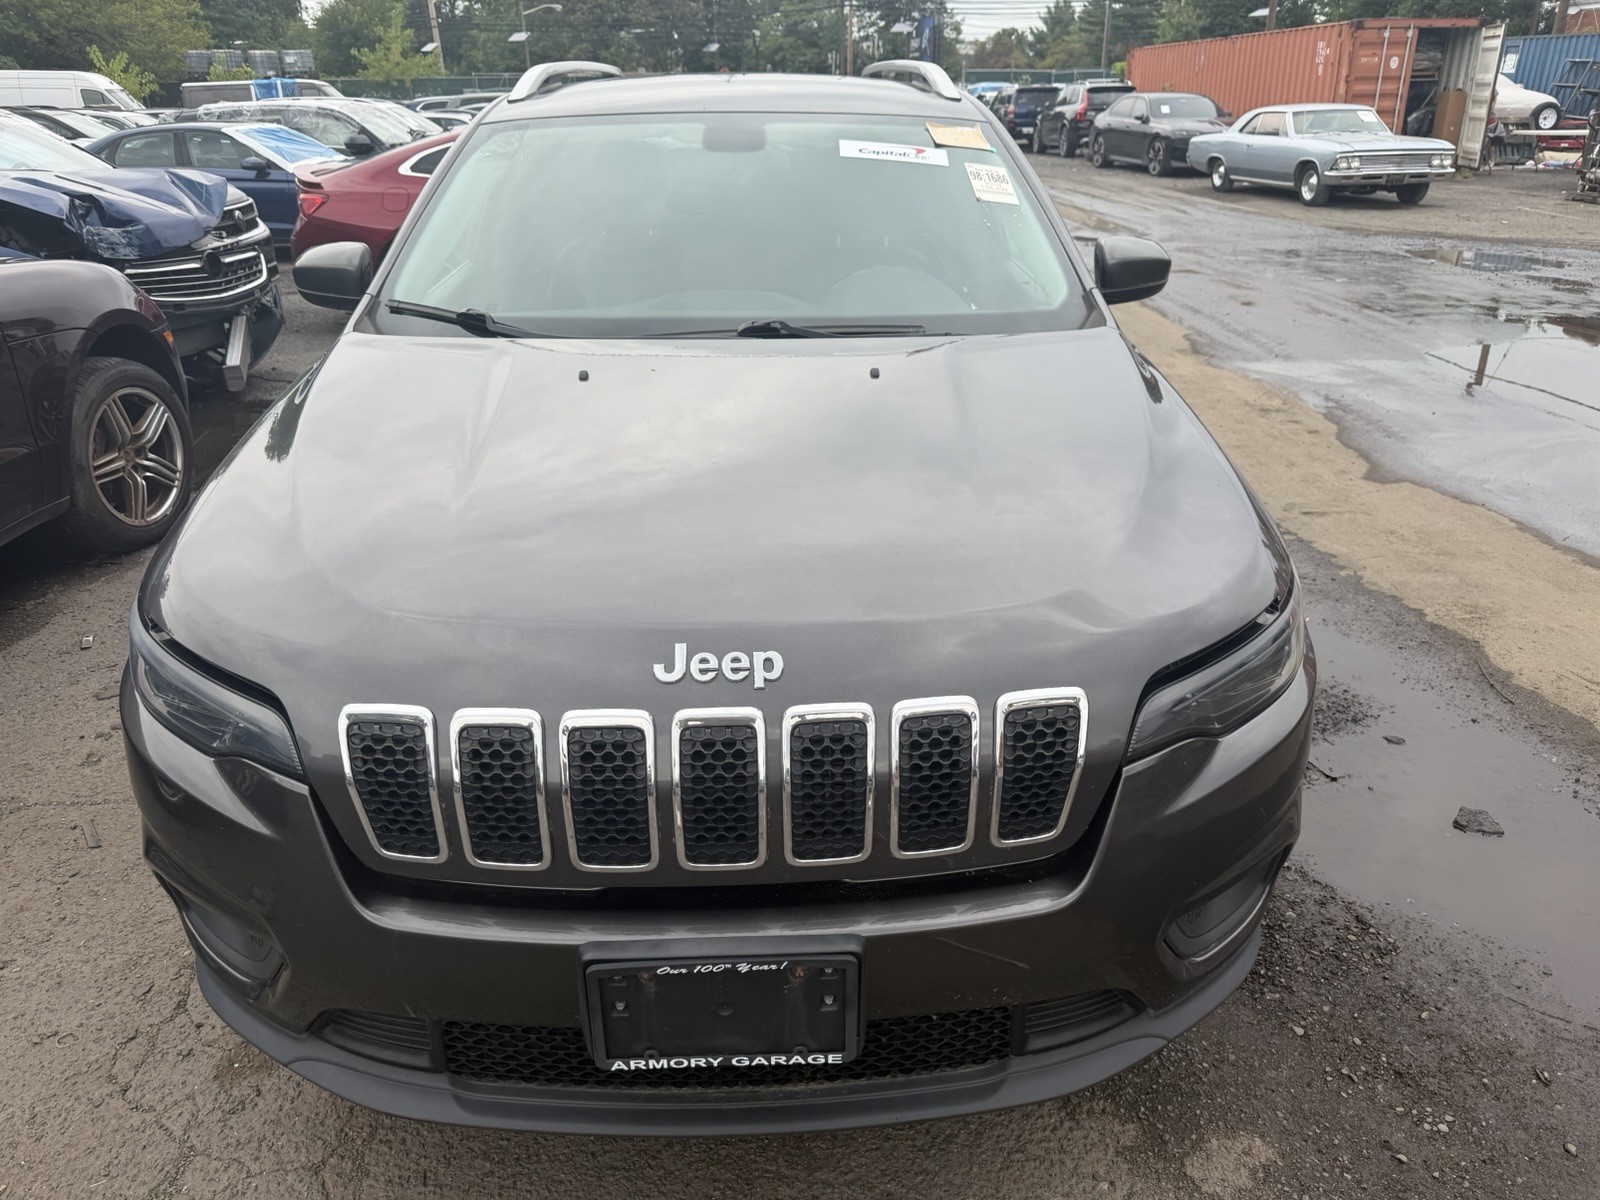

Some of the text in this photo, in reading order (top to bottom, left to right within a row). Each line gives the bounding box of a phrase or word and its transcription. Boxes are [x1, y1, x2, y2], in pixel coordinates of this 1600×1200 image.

[653, 642, 784, 690] Jeep
[656, 966, 688, 975] Our
[610, 1054, 843, 1071] ARMORY GARAGE
